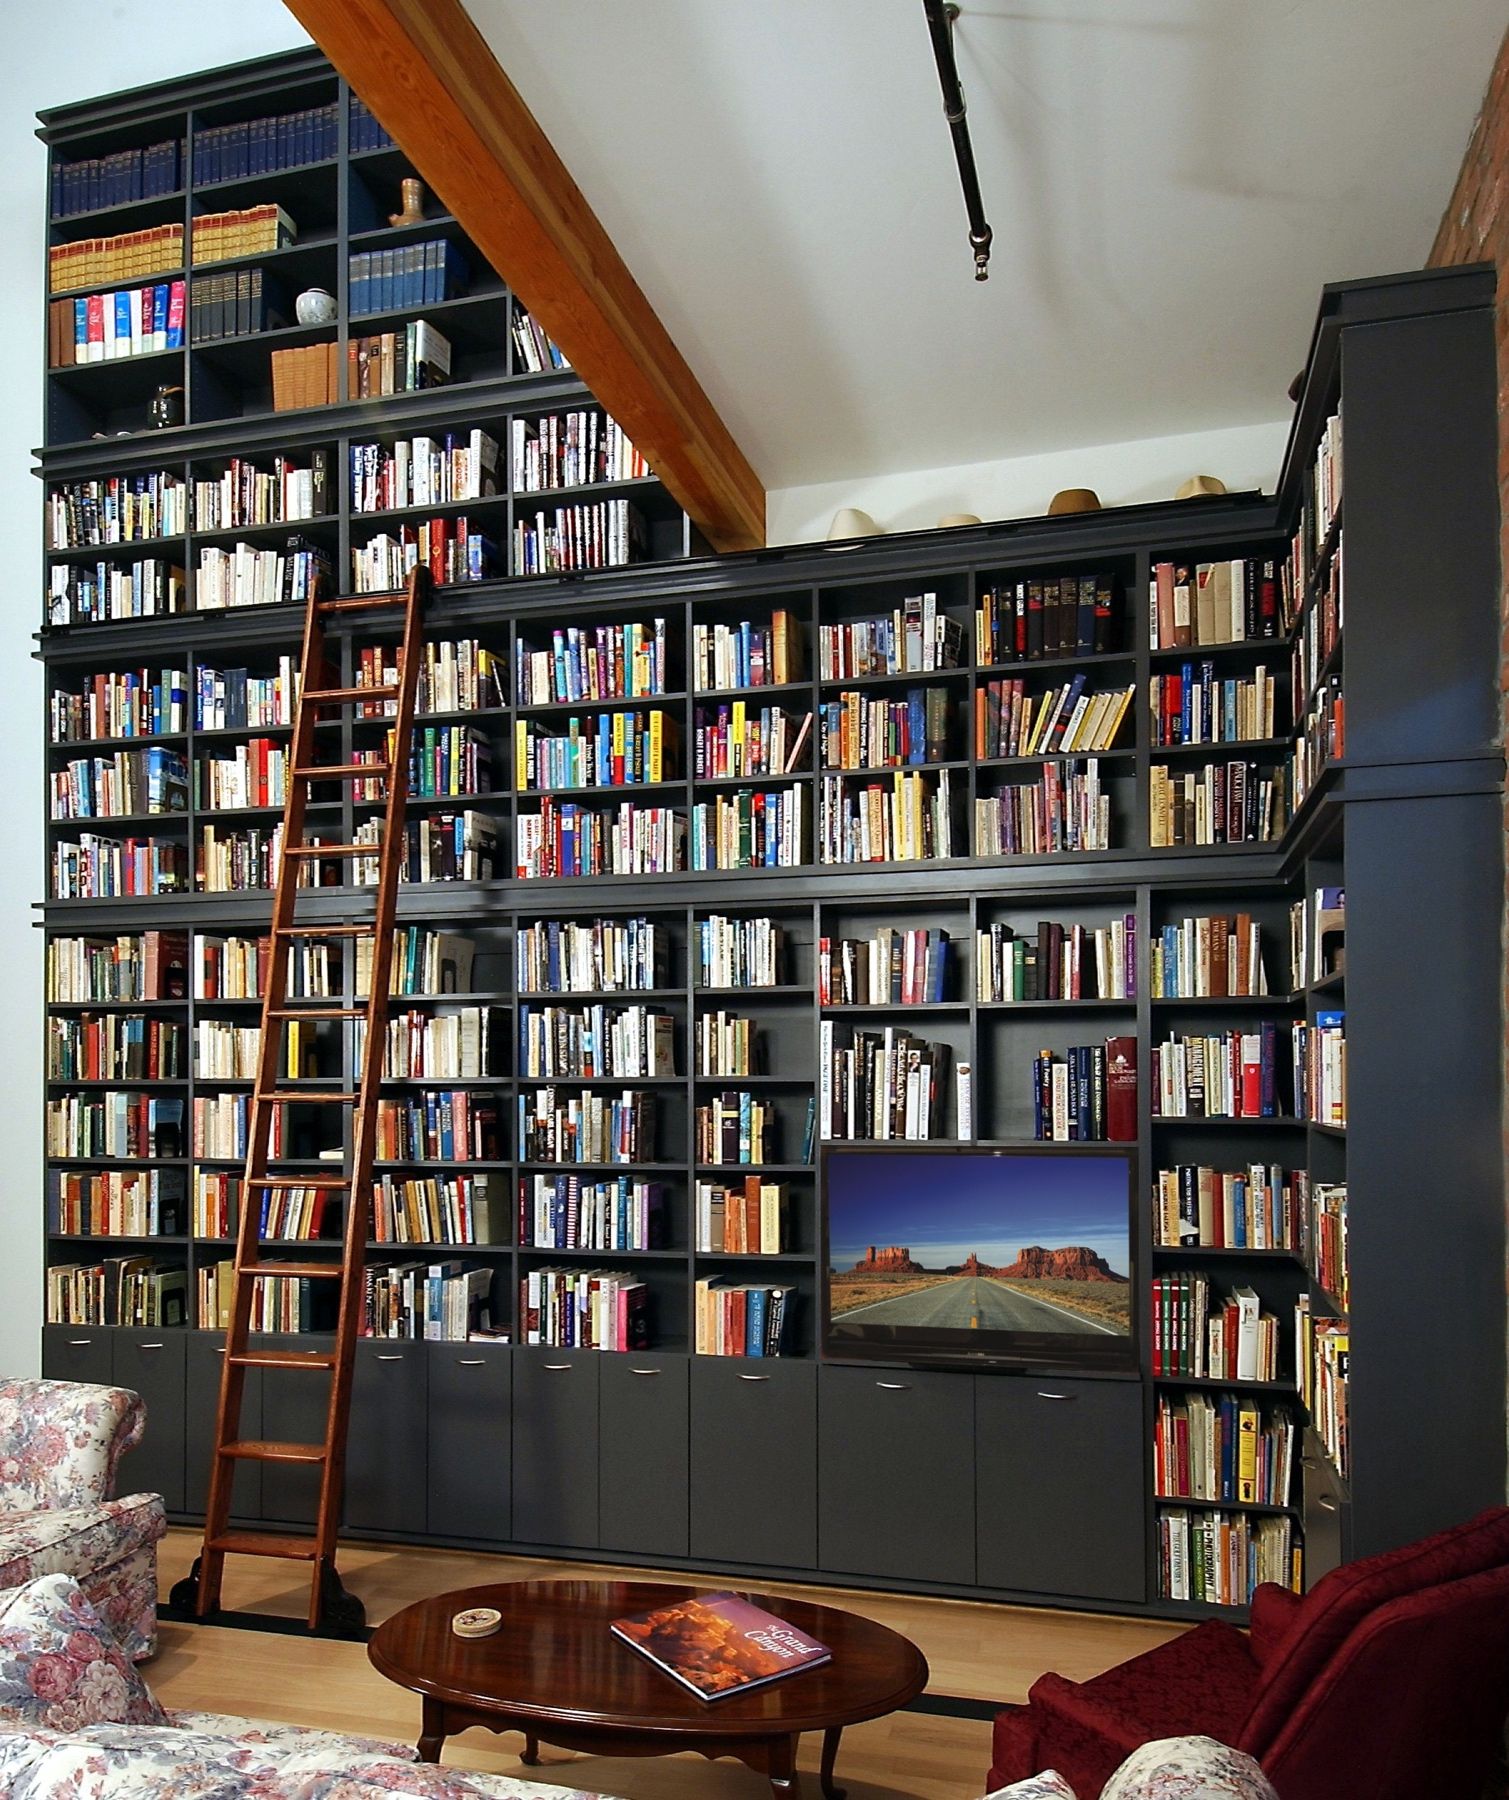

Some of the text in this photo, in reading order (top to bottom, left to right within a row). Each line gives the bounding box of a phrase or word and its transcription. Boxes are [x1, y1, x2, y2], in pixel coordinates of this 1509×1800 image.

[1192, 1038, 1203, 1086] MANAGEMENT
[744, 1630, 795, 1658] Canyon
[772, 1630, 822, 1654] Grand
